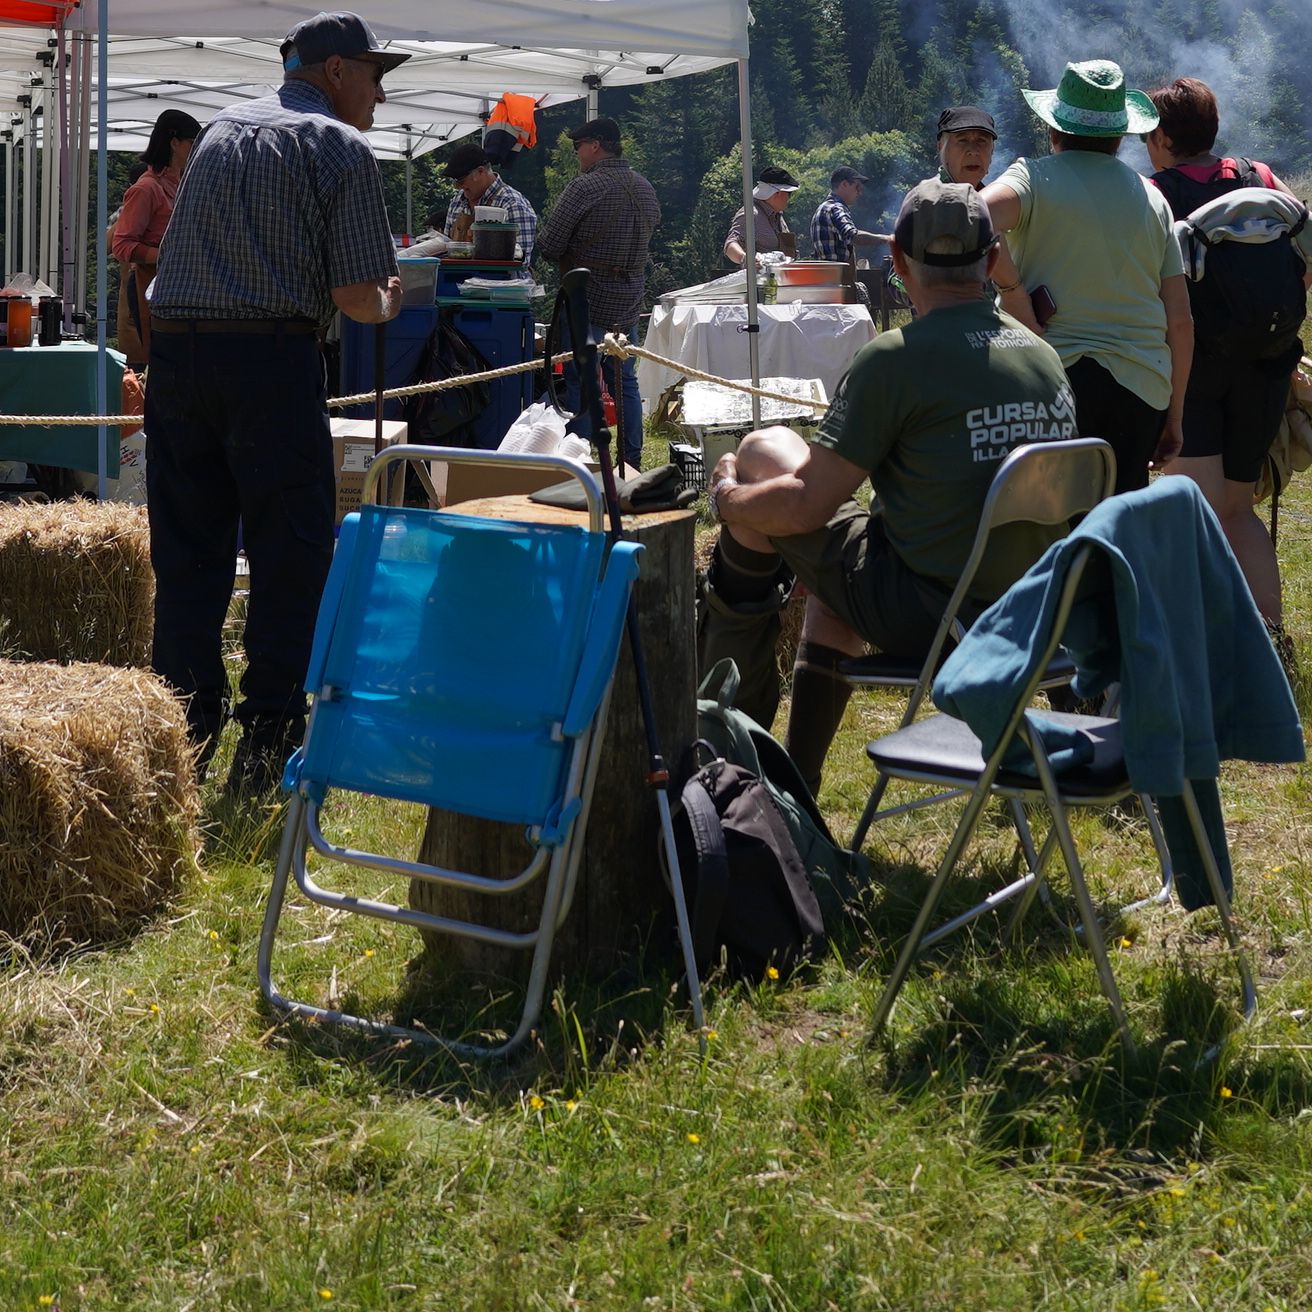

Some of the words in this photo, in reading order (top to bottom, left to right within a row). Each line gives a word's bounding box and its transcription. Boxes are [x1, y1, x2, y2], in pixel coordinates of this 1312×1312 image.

[966, 401, 1049, 429] CURSA
[970, 421, 1073, 449] POPULAR
[973, 446, 1009, 462] ILLA
